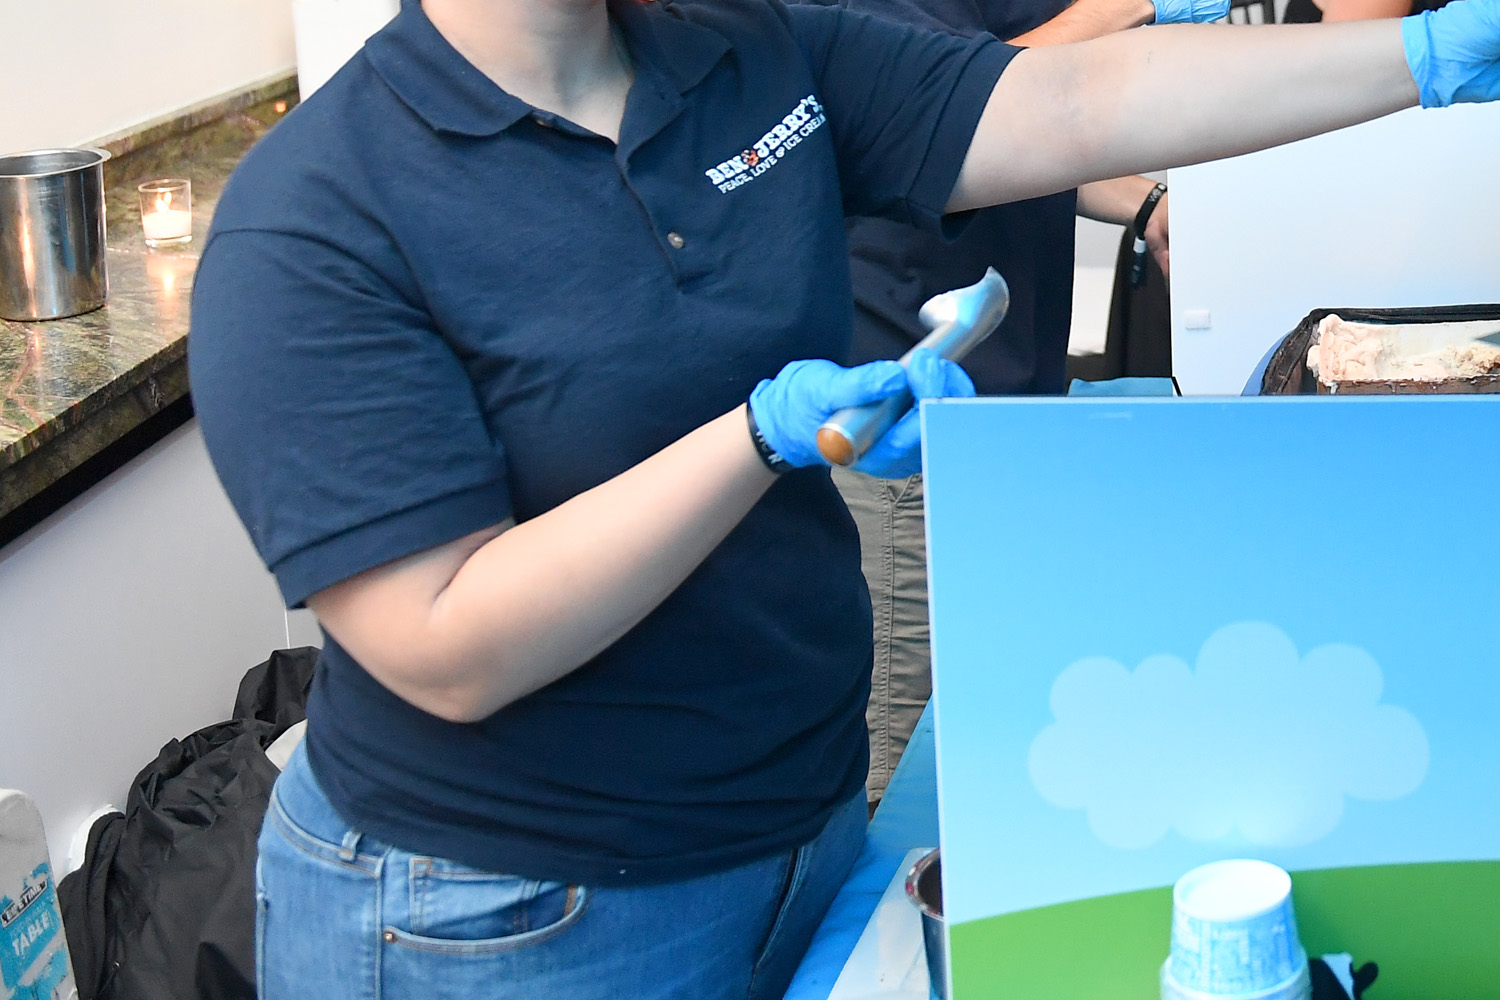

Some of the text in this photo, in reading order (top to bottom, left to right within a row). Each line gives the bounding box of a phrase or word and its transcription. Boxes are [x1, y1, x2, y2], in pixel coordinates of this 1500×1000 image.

[705, 94, 819, 185] BEN JERRY'S
[718, 173, 754, 195] PEACE,
[749, 155, 778, 176] LOVE
[782, 133, 803, 150] ICE
[12, 910, 51, 956] TABLE
